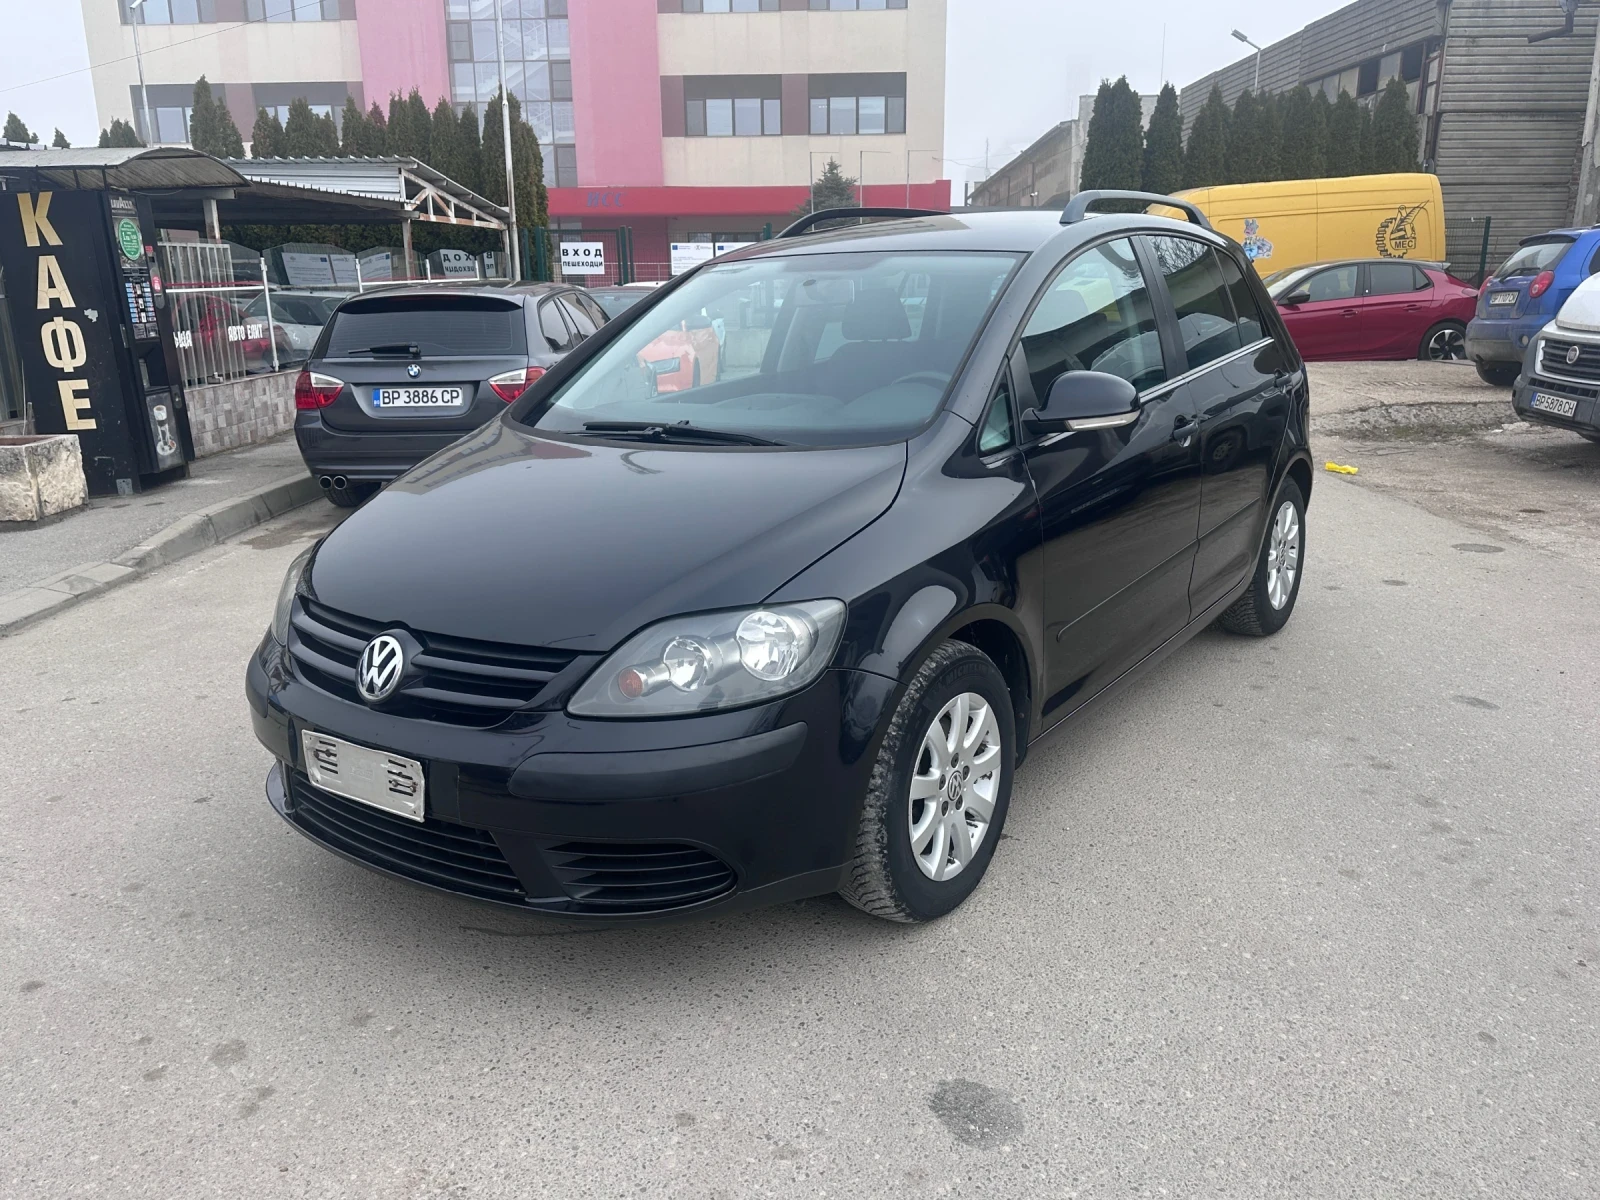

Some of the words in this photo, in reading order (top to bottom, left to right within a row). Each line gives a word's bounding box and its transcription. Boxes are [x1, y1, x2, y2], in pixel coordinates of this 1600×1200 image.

[562, 248, 602, 258] ВХОД
[562, 260, 603, 268] ПЕШЕХОДЦИ
[17, 191, 97, 431] КАФЕ
[228, 325, 245, 342] АВТО
[247, 323, 263, 340] ЕЛИТ
[404, 390, 438, 404] 3886
